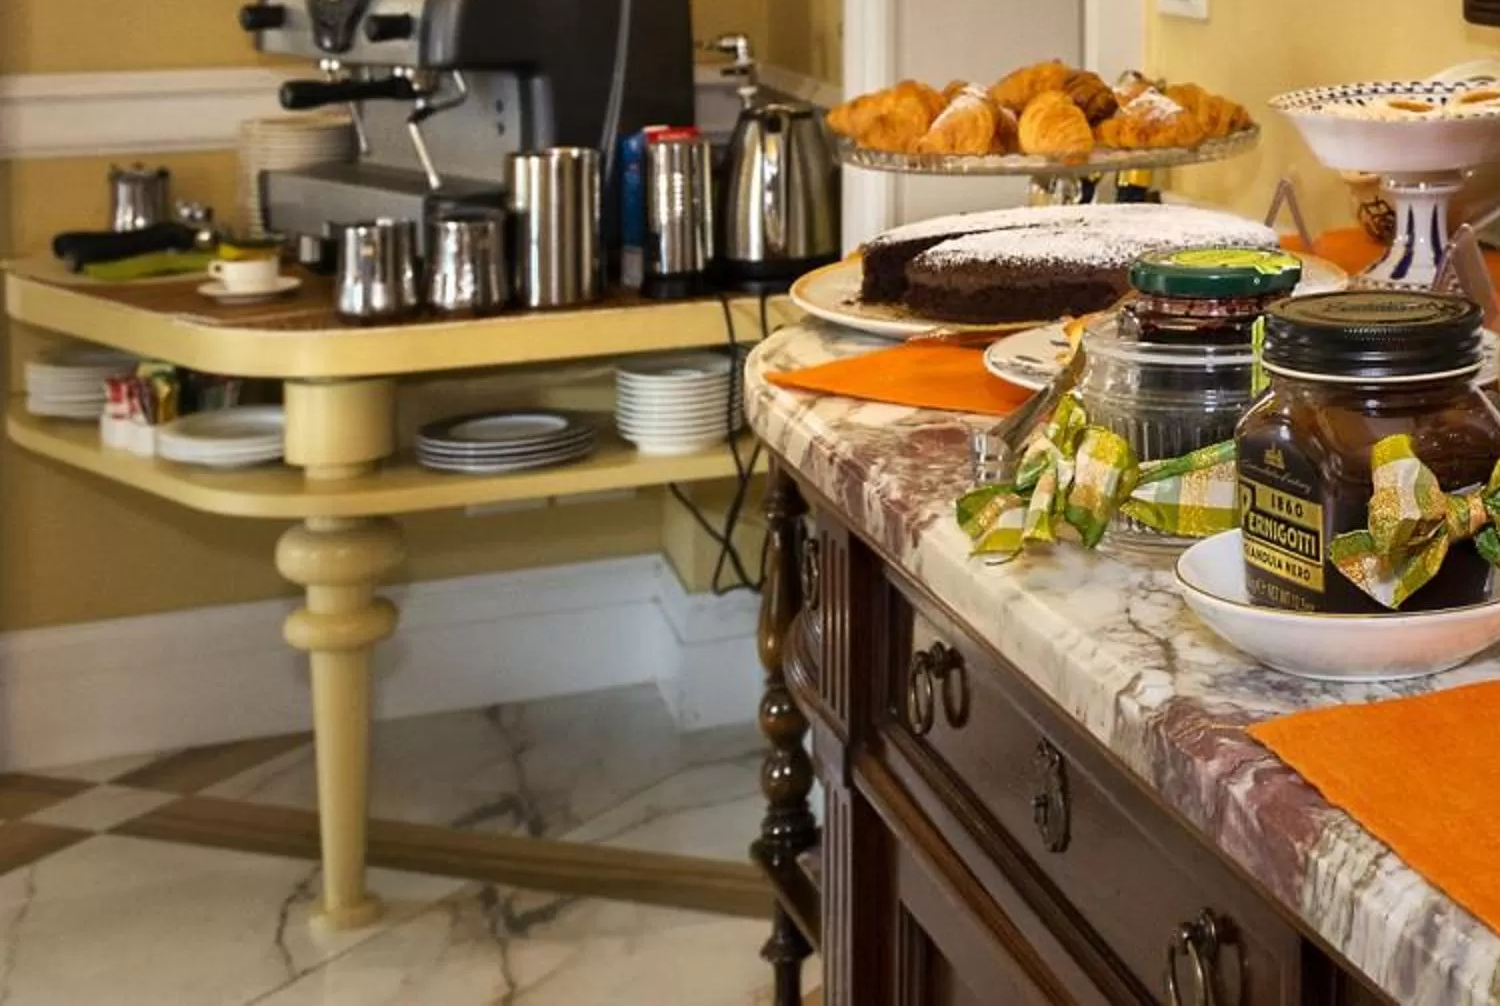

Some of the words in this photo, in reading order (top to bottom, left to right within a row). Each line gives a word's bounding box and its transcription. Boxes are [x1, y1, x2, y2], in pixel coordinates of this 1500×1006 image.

[1240, 481, 1316, 557] PERNIGOTTI
[1271, 494, 1304, 517] 1860
[1244, 544, 1283, 572] ANDUIA
